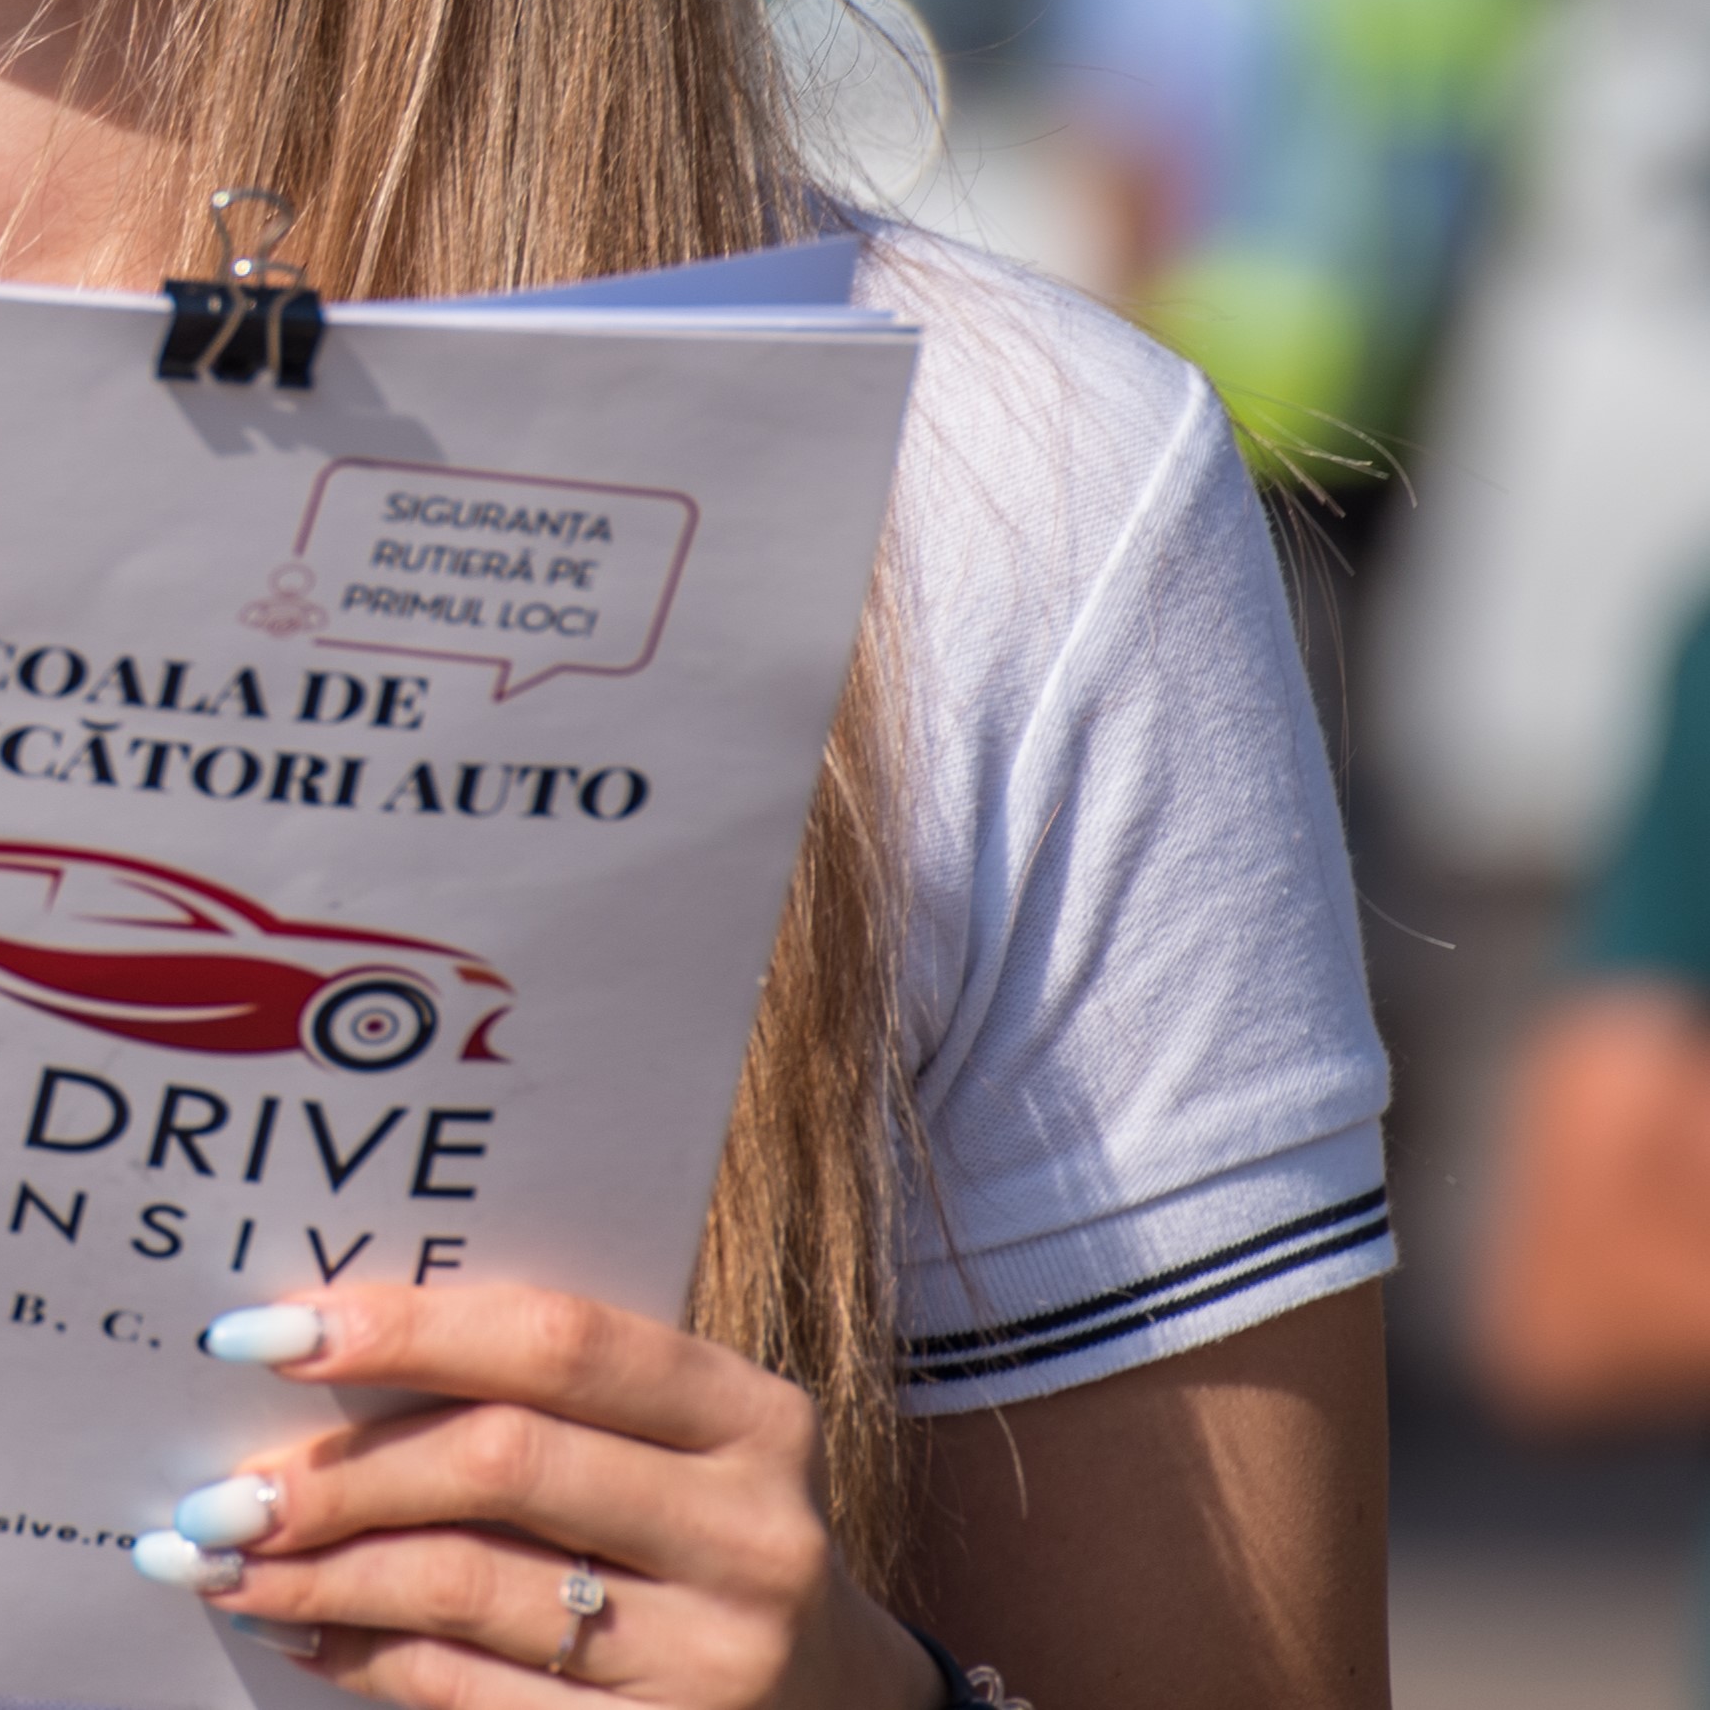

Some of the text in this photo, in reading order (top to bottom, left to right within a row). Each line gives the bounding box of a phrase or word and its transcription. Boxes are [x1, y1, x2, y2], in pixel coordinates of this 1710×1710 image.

[544, 555, 598, 591] PE
[339, 582, 485, 629] PRIMUL
[296, 670, 429, 731] DE
[382, 761, 650, 820] AUTO
[23, 1065, 495, 1201] DRIVE
